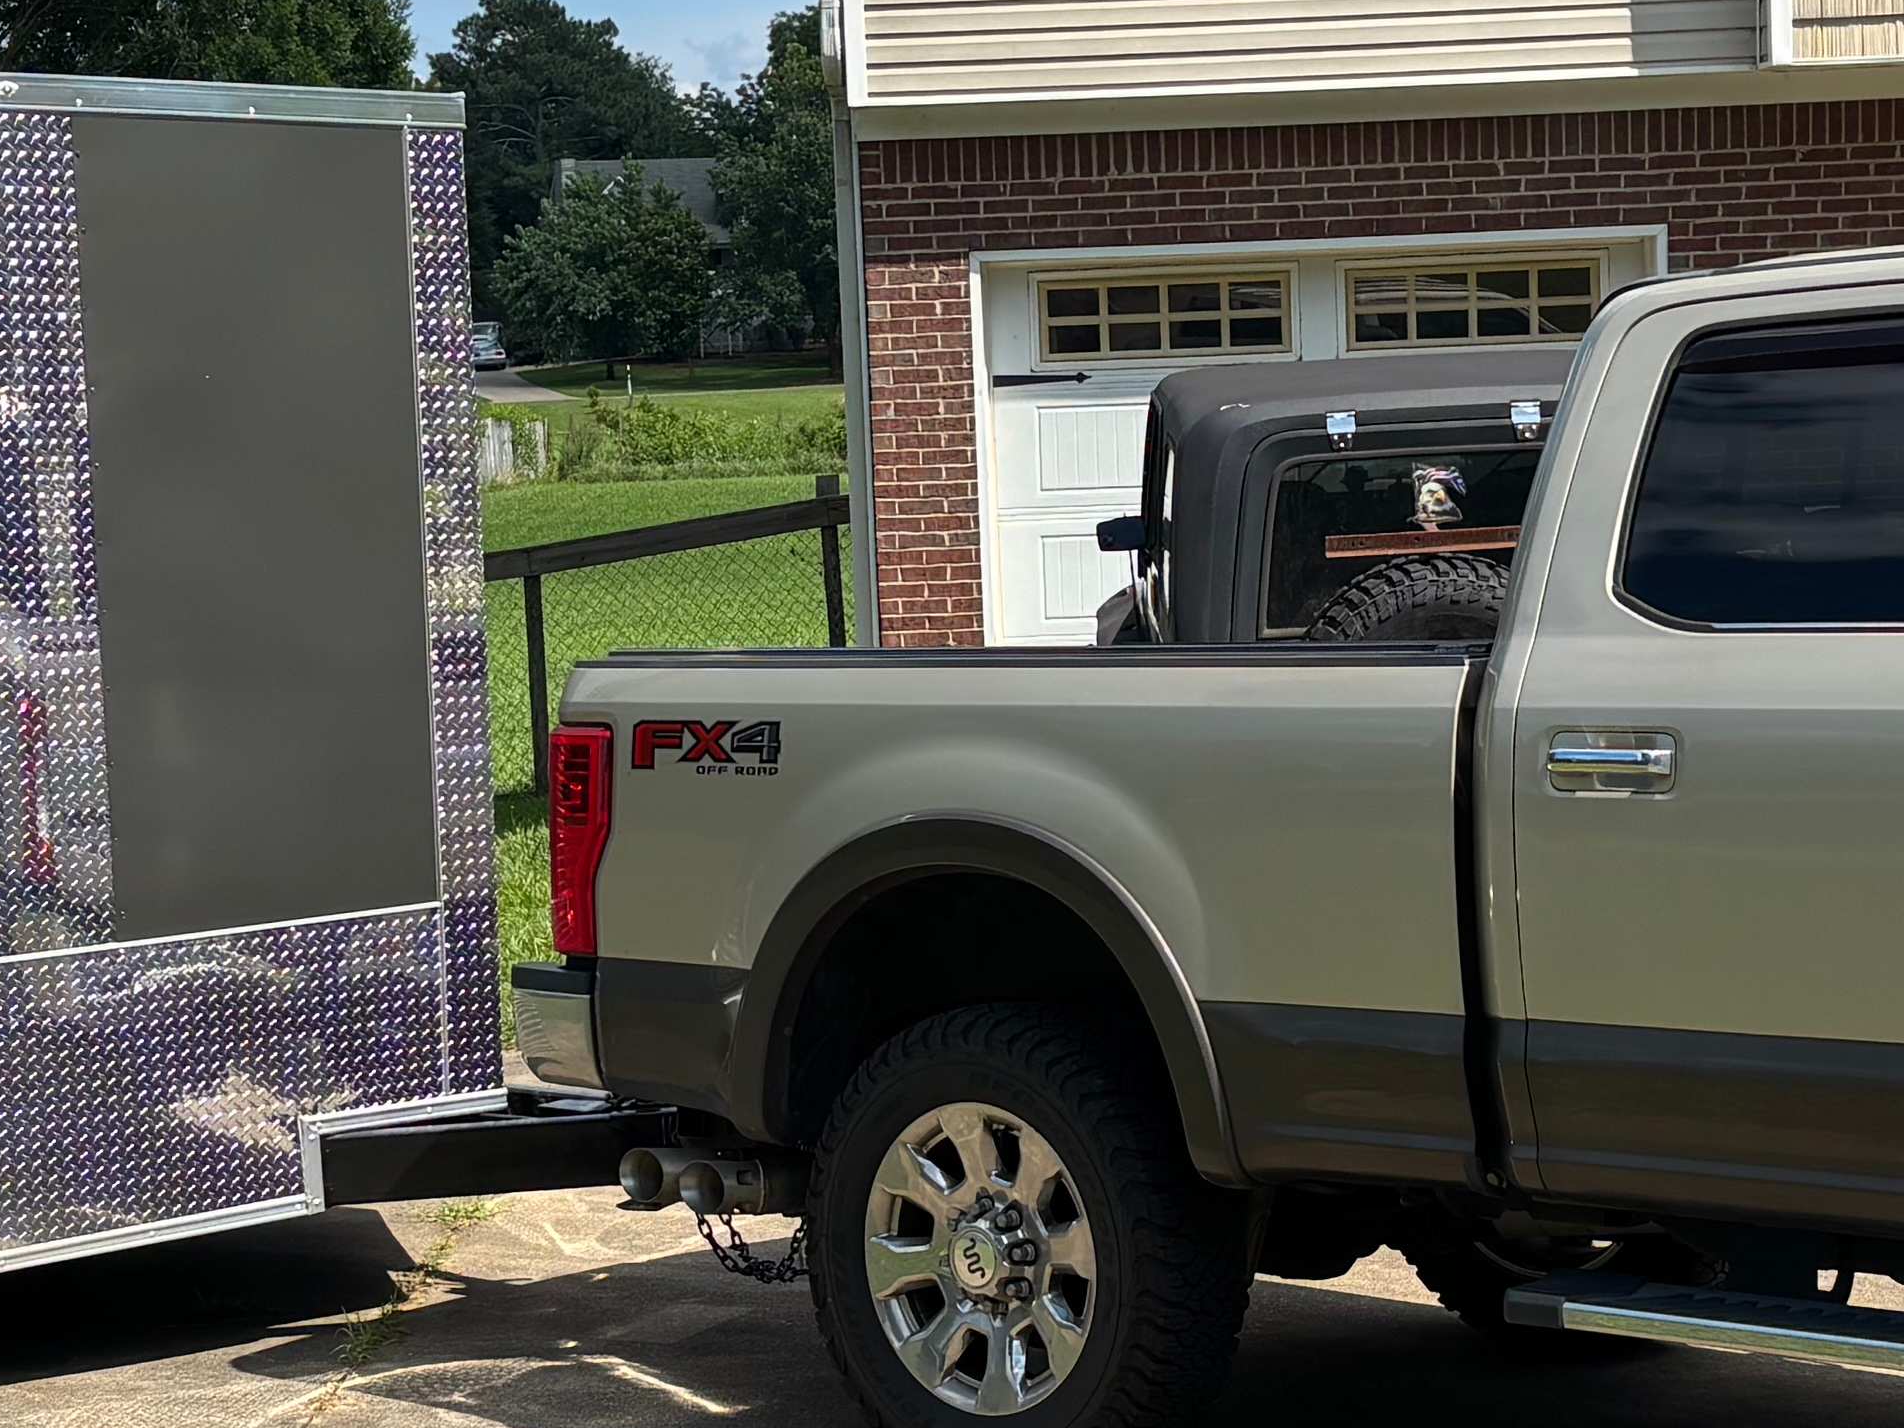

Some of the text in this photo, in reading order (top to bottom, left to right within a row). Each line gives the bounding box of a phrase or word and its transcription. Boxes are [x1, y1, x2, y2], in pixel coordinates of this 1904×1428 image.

[631, 720, 781, 770] FX4
[696, 765, 779, 777] OFF ROAD
